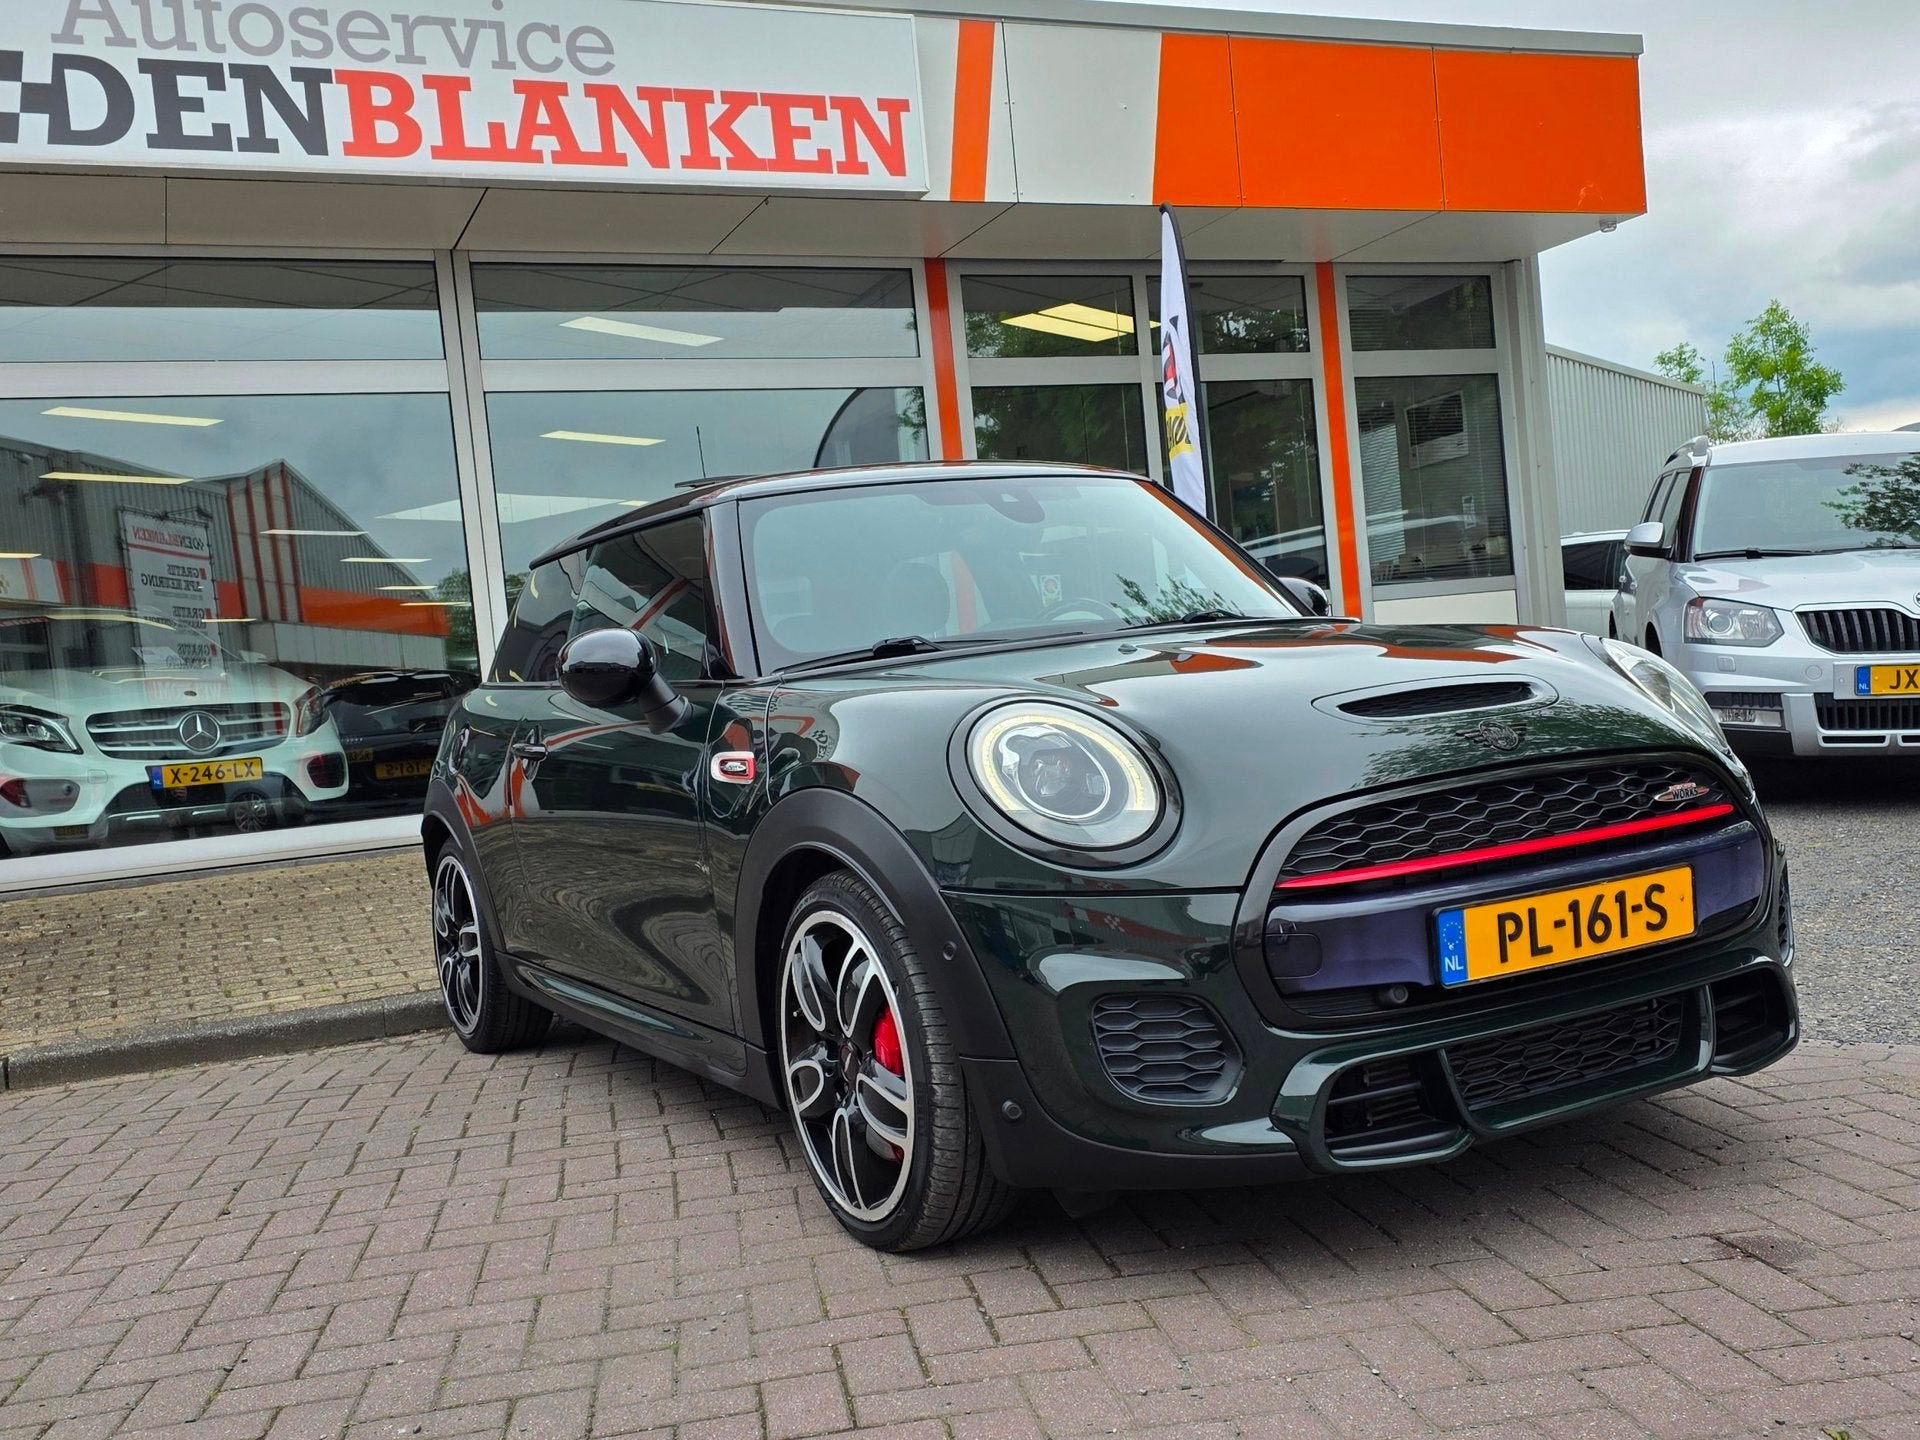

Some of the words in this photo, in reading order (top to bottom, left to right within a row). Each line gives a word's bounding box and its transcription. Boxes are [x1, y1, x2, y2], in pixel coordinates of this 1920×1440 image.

[50, 0, 616, 75] Autoservice
[170, 761, 255, 784] X-246-LX
[1445, 955, 1464, 972] NL
[1497, 883, 1668, 964] PL-161-S
